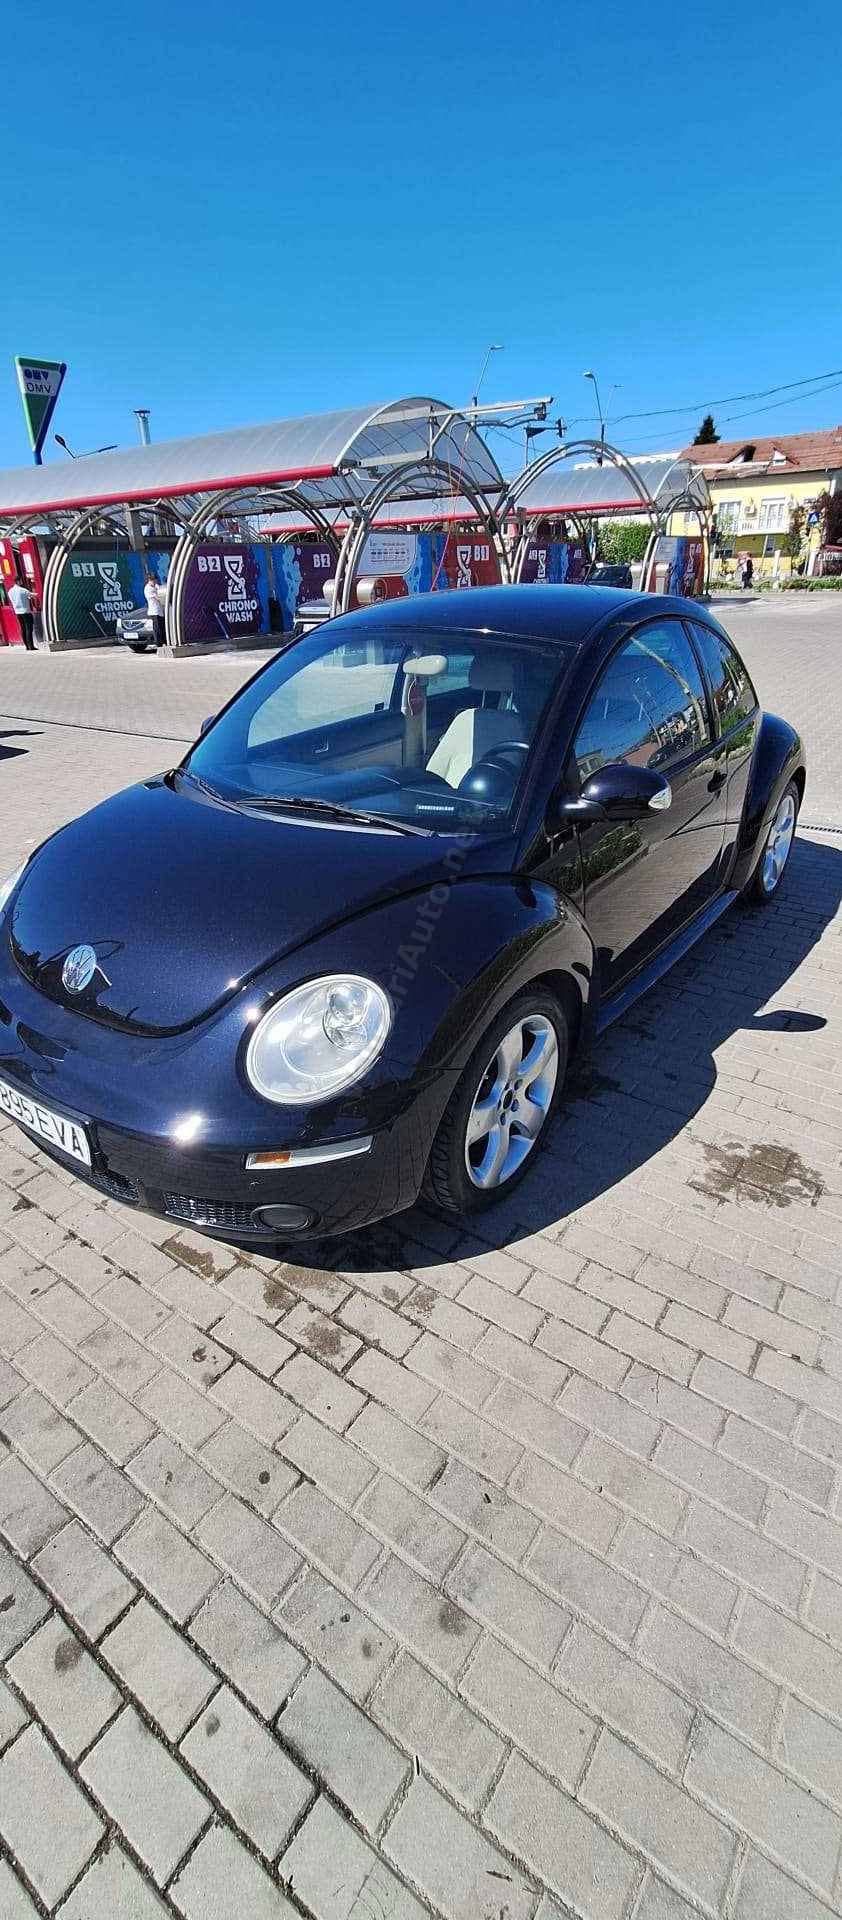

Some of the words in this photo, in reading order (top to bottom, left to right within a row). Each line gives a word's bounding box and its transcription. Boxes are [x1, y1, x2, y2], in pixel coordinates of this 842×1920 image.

[26, 382, 51, 394] OMV
[197, 555, 222, 572] B2
[94, 600, 134, 613] CHRONO
[218, 599, 258, 613] CHRONO
[225, 611, 253, 623] WASH
